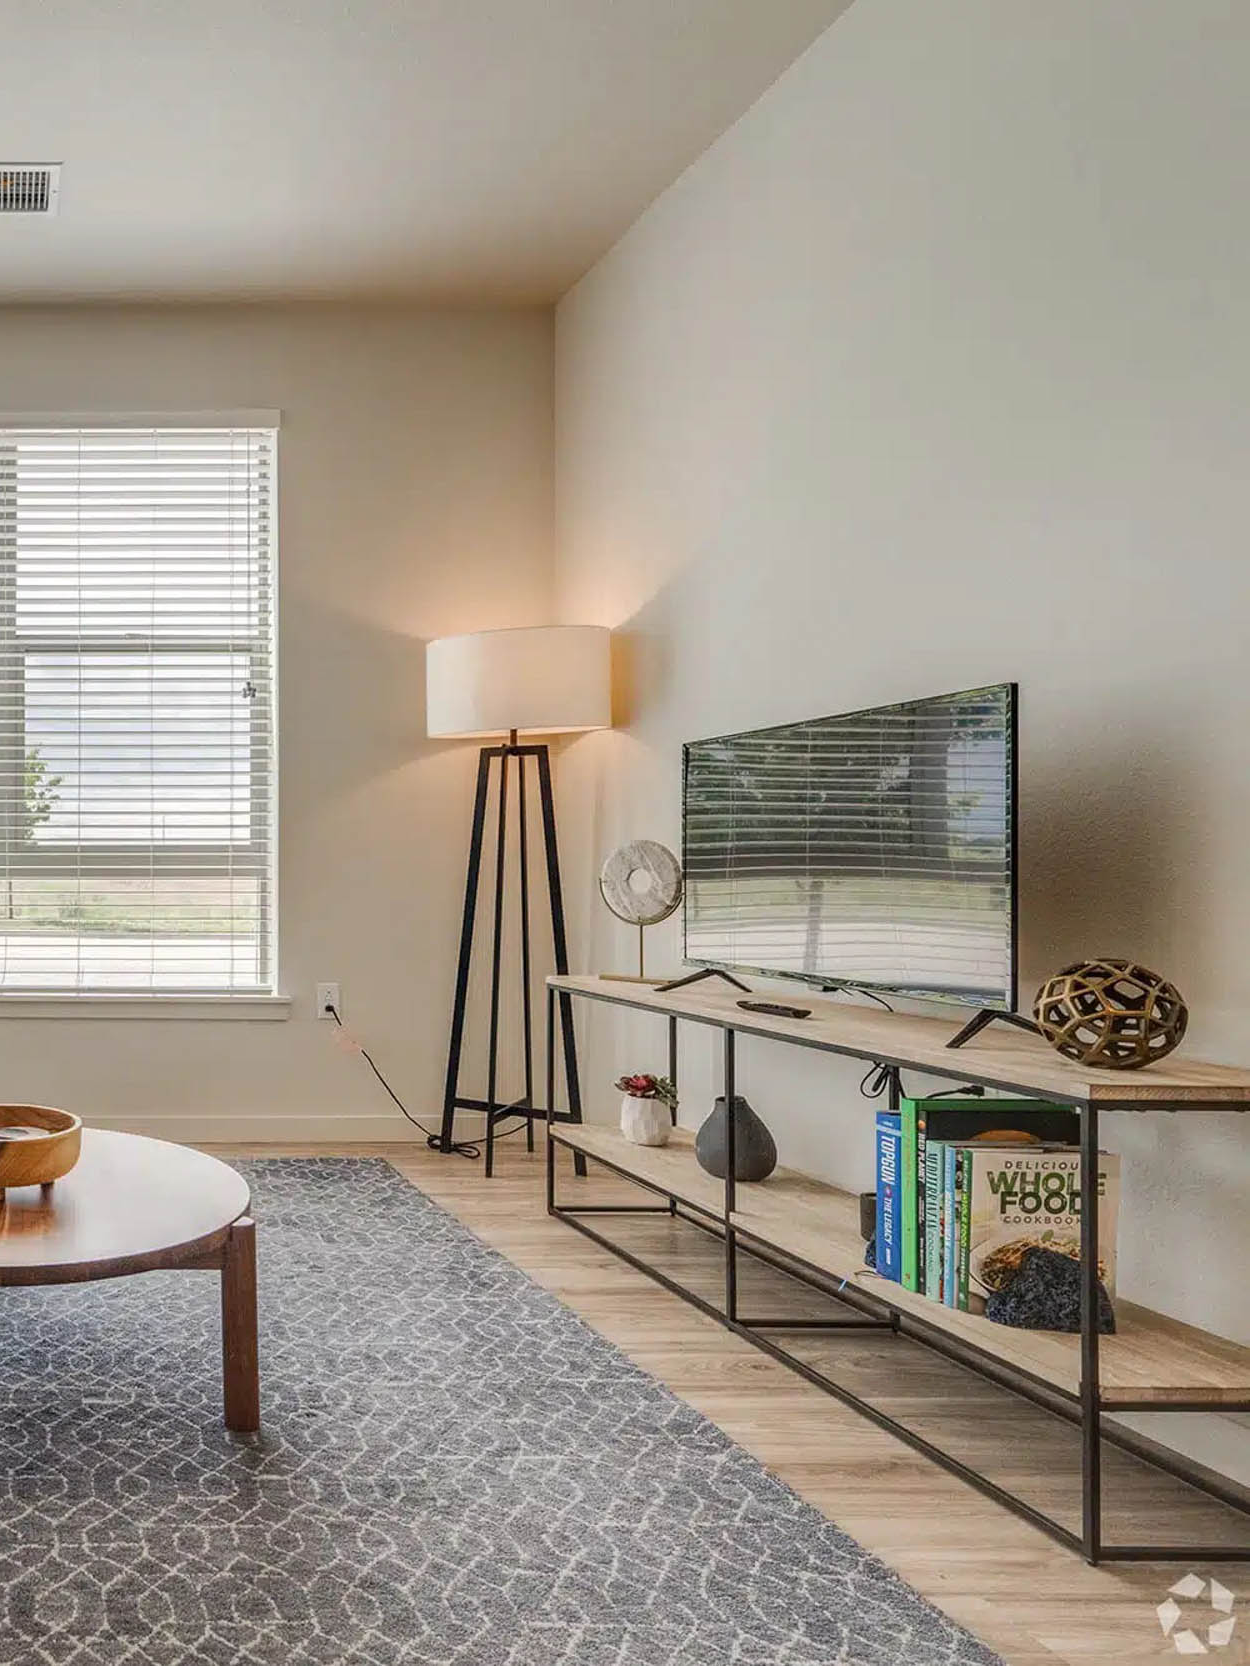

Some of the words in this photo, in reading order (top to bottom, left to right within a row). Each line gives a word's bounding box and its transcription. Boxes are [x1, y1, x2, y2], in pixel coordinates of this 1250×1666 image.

[918, 1133, 926, 1151] RED
[881, 1135, 896, 1185] TOPGUN
[1004, 1160, 1080, 1171] DELICIOU
[884, 1197, 892, 1213] THE
[884, 1213, 893, 1245] LEGACY
[960, 1224, 968, 1247] FOOD
